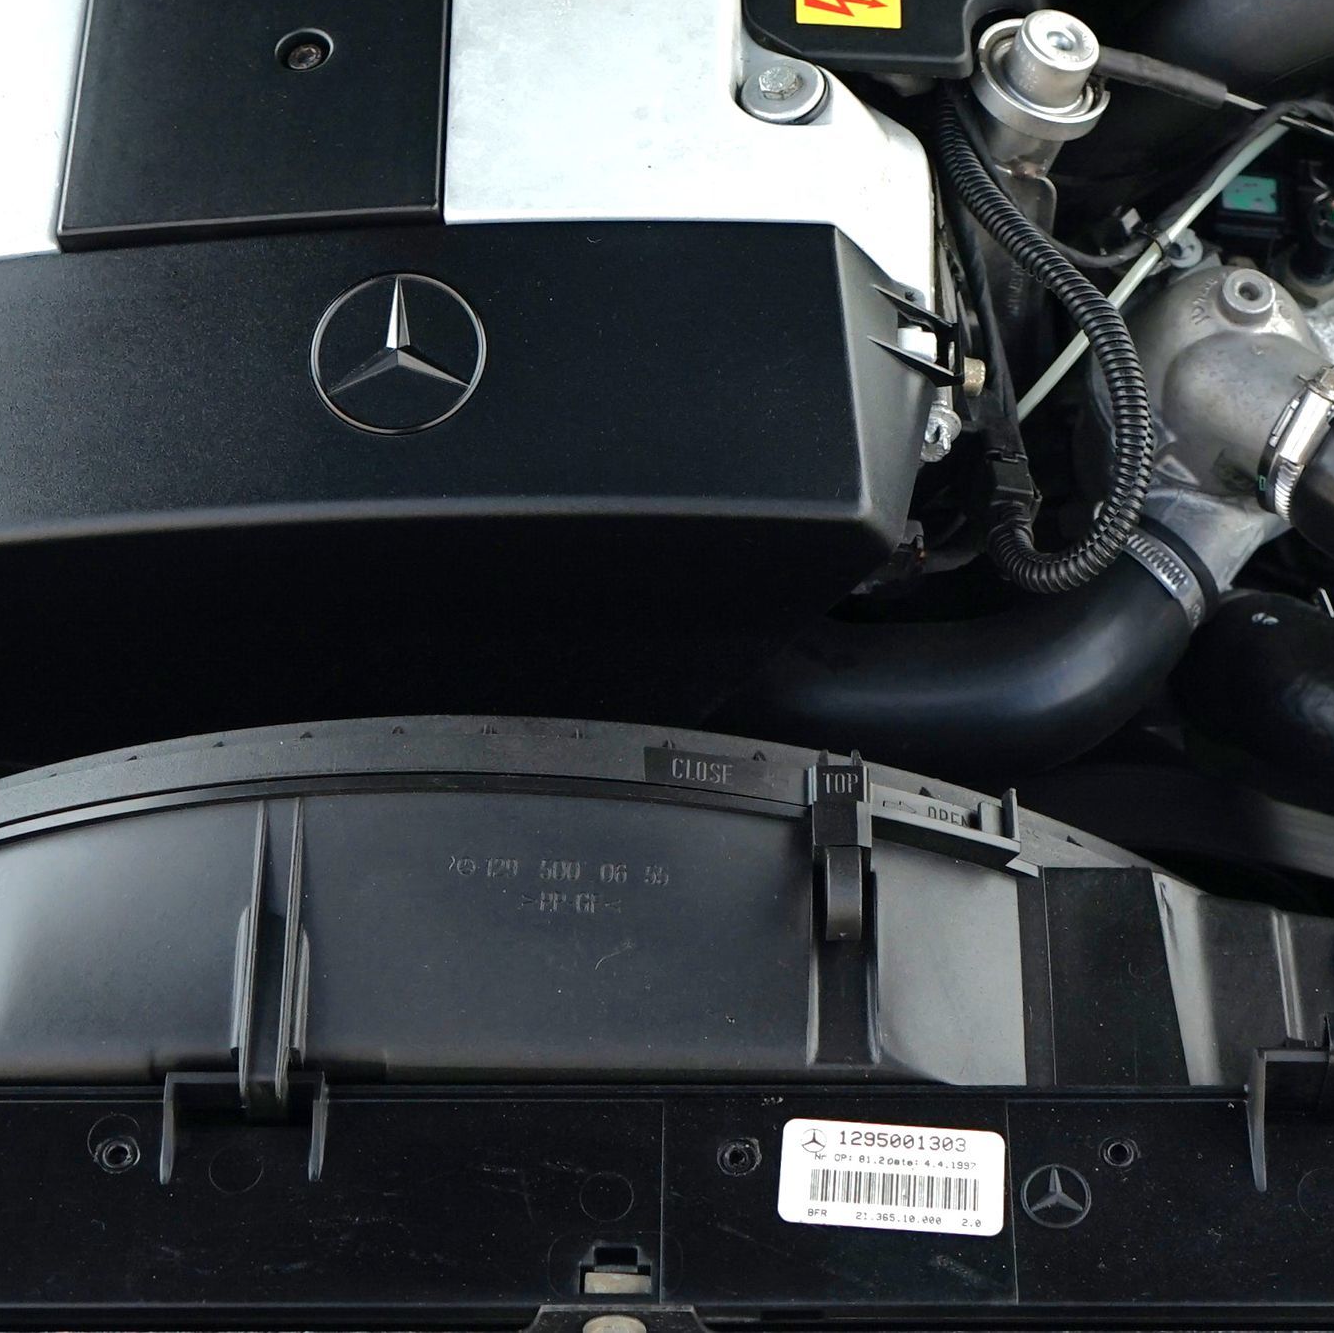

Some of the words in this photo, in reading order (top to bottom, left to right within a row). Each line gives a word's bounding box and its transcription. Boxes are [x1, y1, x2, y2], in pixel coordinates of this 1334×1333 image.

[671, 757, 733, 785] CLOSE
[822, 772, 860, 794] TOP
[839, 1130, 967, 1153] 1295001303
